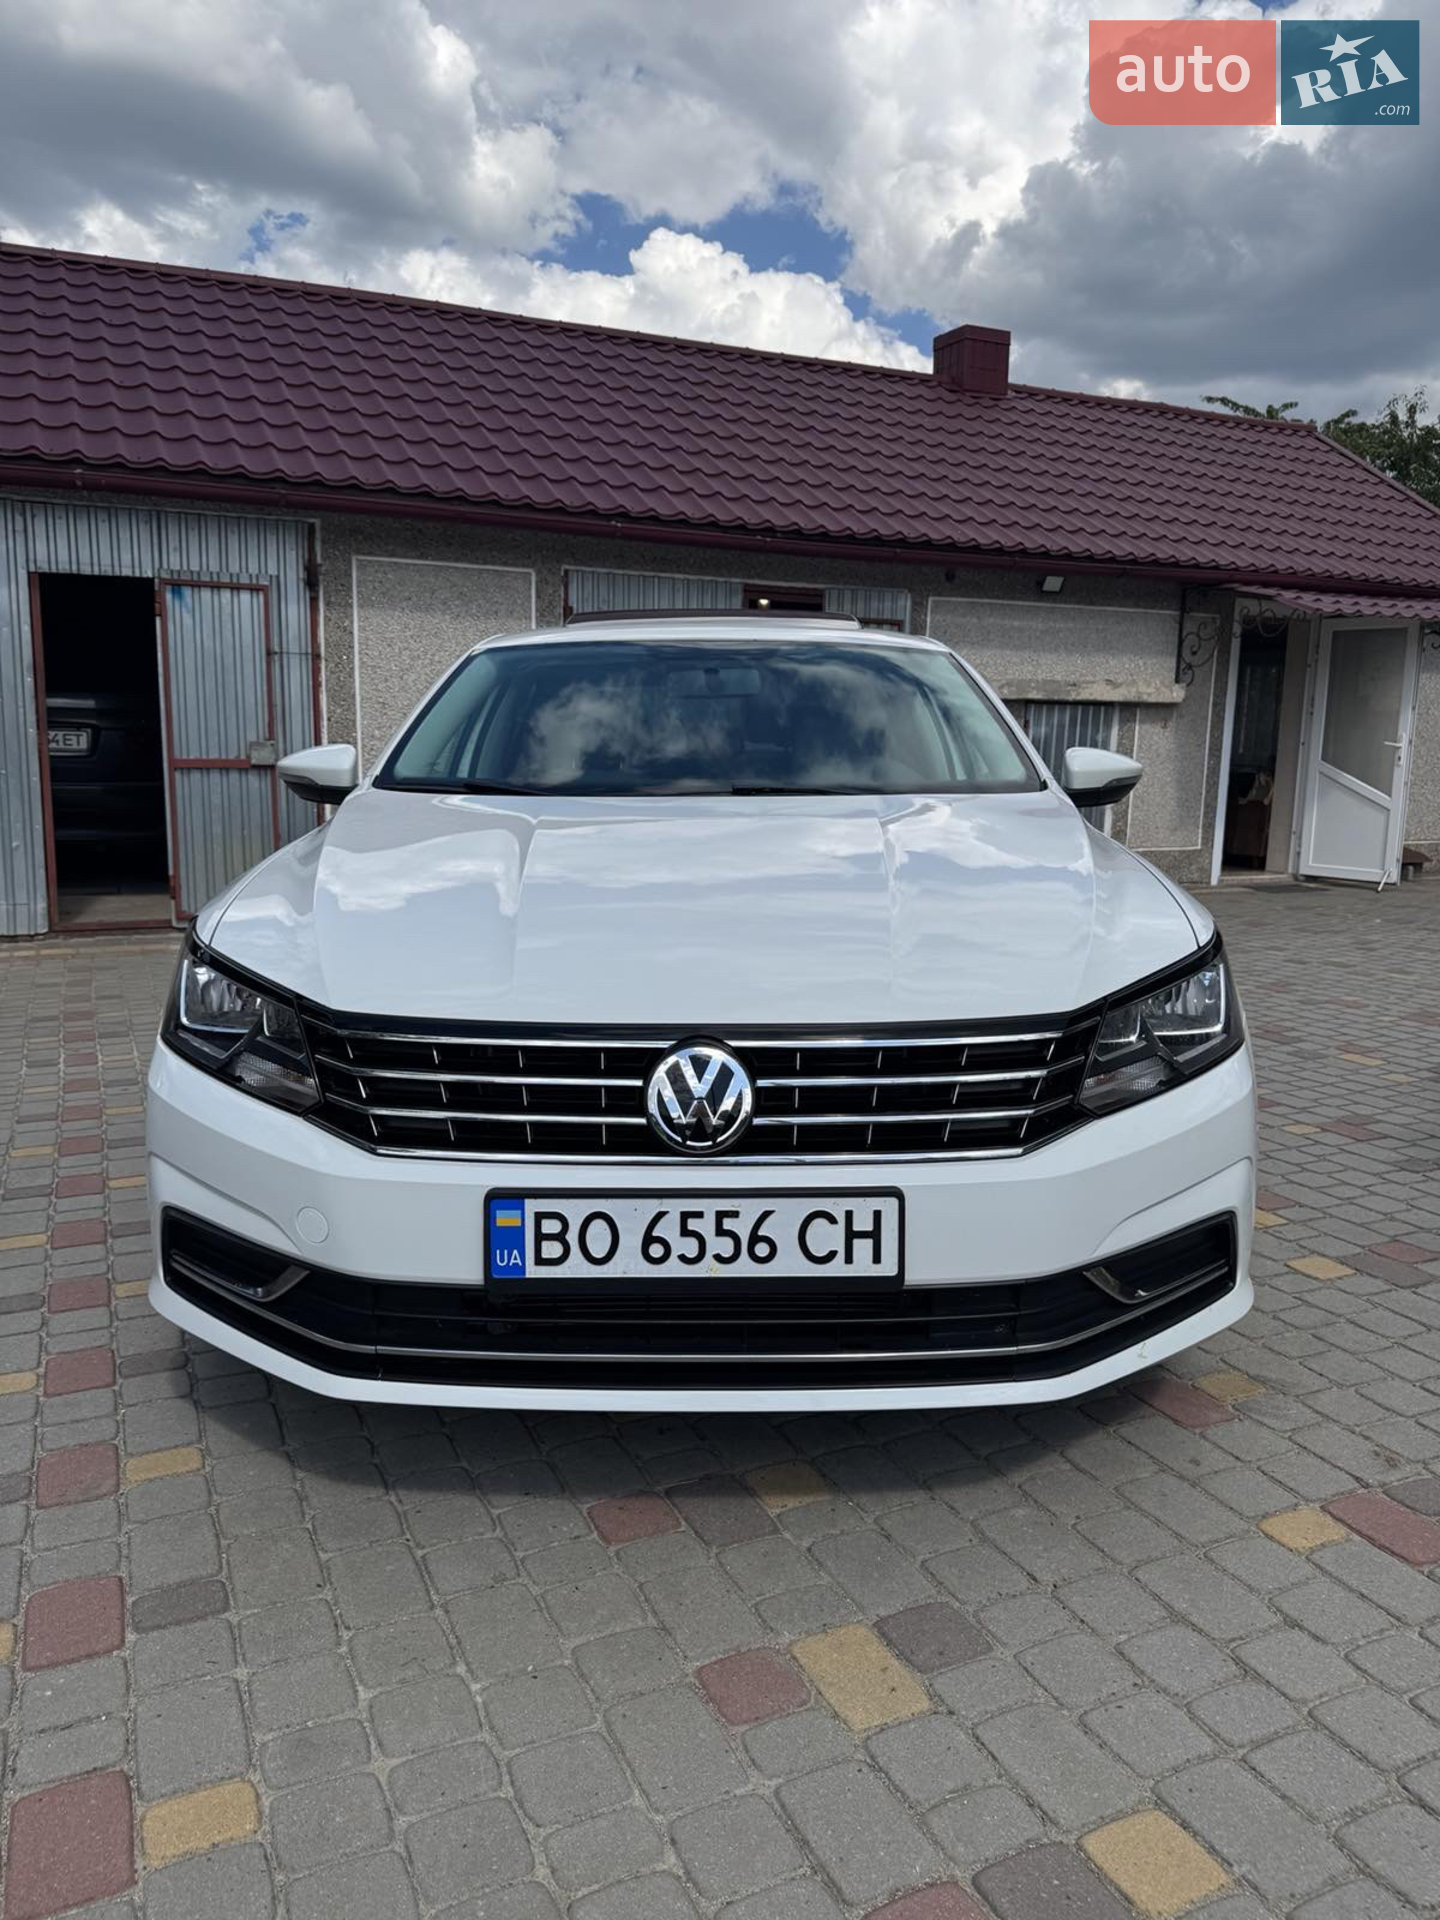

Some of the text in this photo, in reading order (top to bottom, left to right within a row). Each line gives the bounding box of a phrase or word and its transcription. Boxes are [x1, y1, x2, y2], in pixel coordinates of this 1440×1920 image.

[534, 1209, 882, 1266] BO 6556 CH
[496, 1249, 523, 1267] UA
